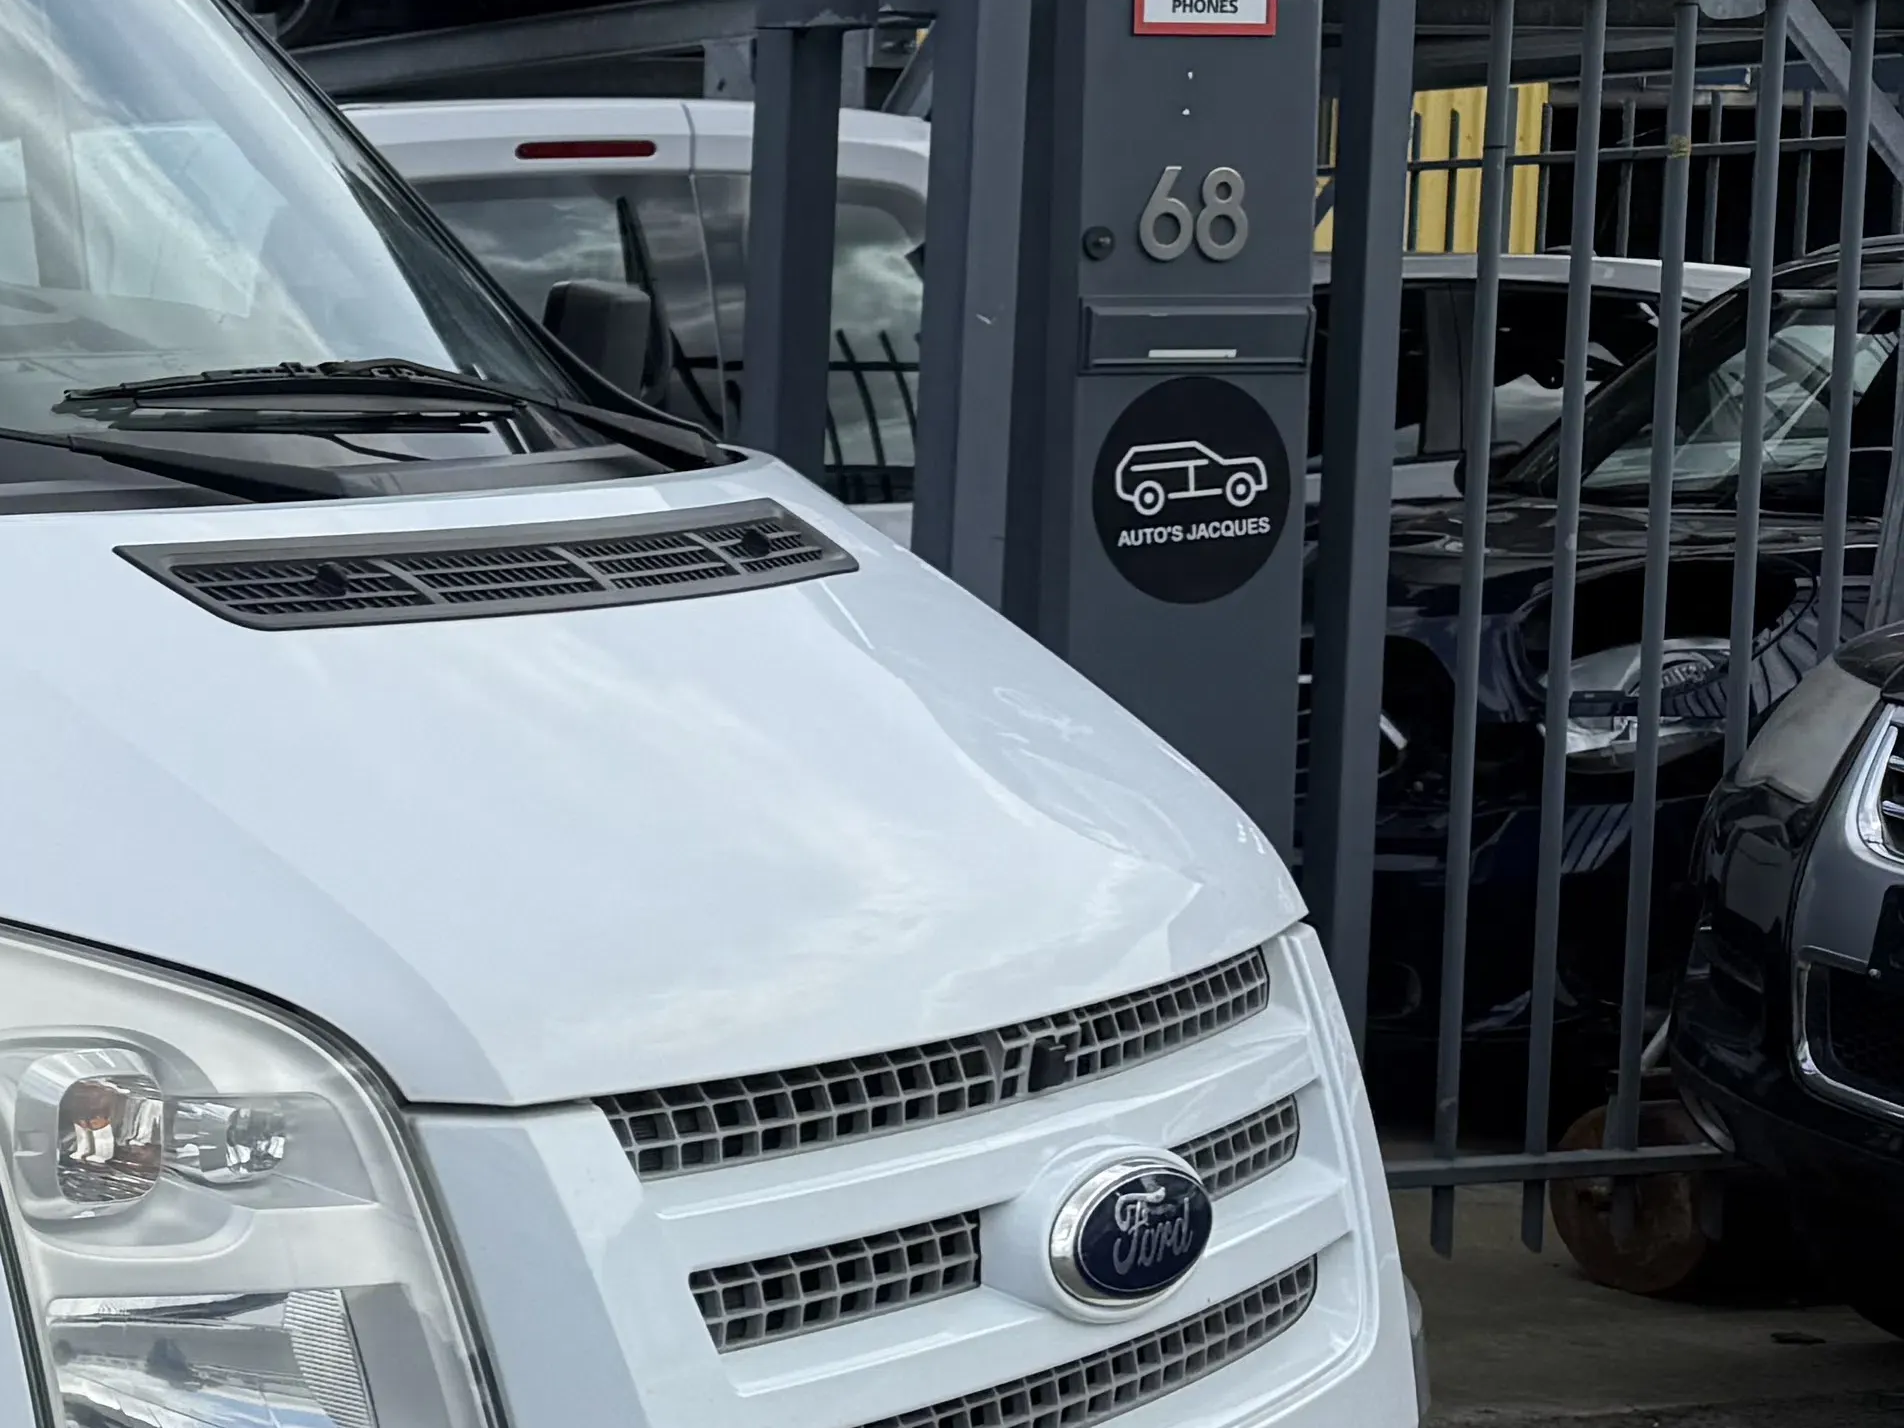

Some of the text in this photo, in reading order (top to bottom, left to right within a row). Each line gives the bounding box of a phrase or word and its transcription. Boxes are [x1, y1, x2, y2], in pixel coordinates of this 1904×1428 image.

[1140, 166, 1249, 262] 68
[1117, 517, 1271, 547] AUTO'S JACQUES
[1112, 1186, 1193, 1275] Ford
